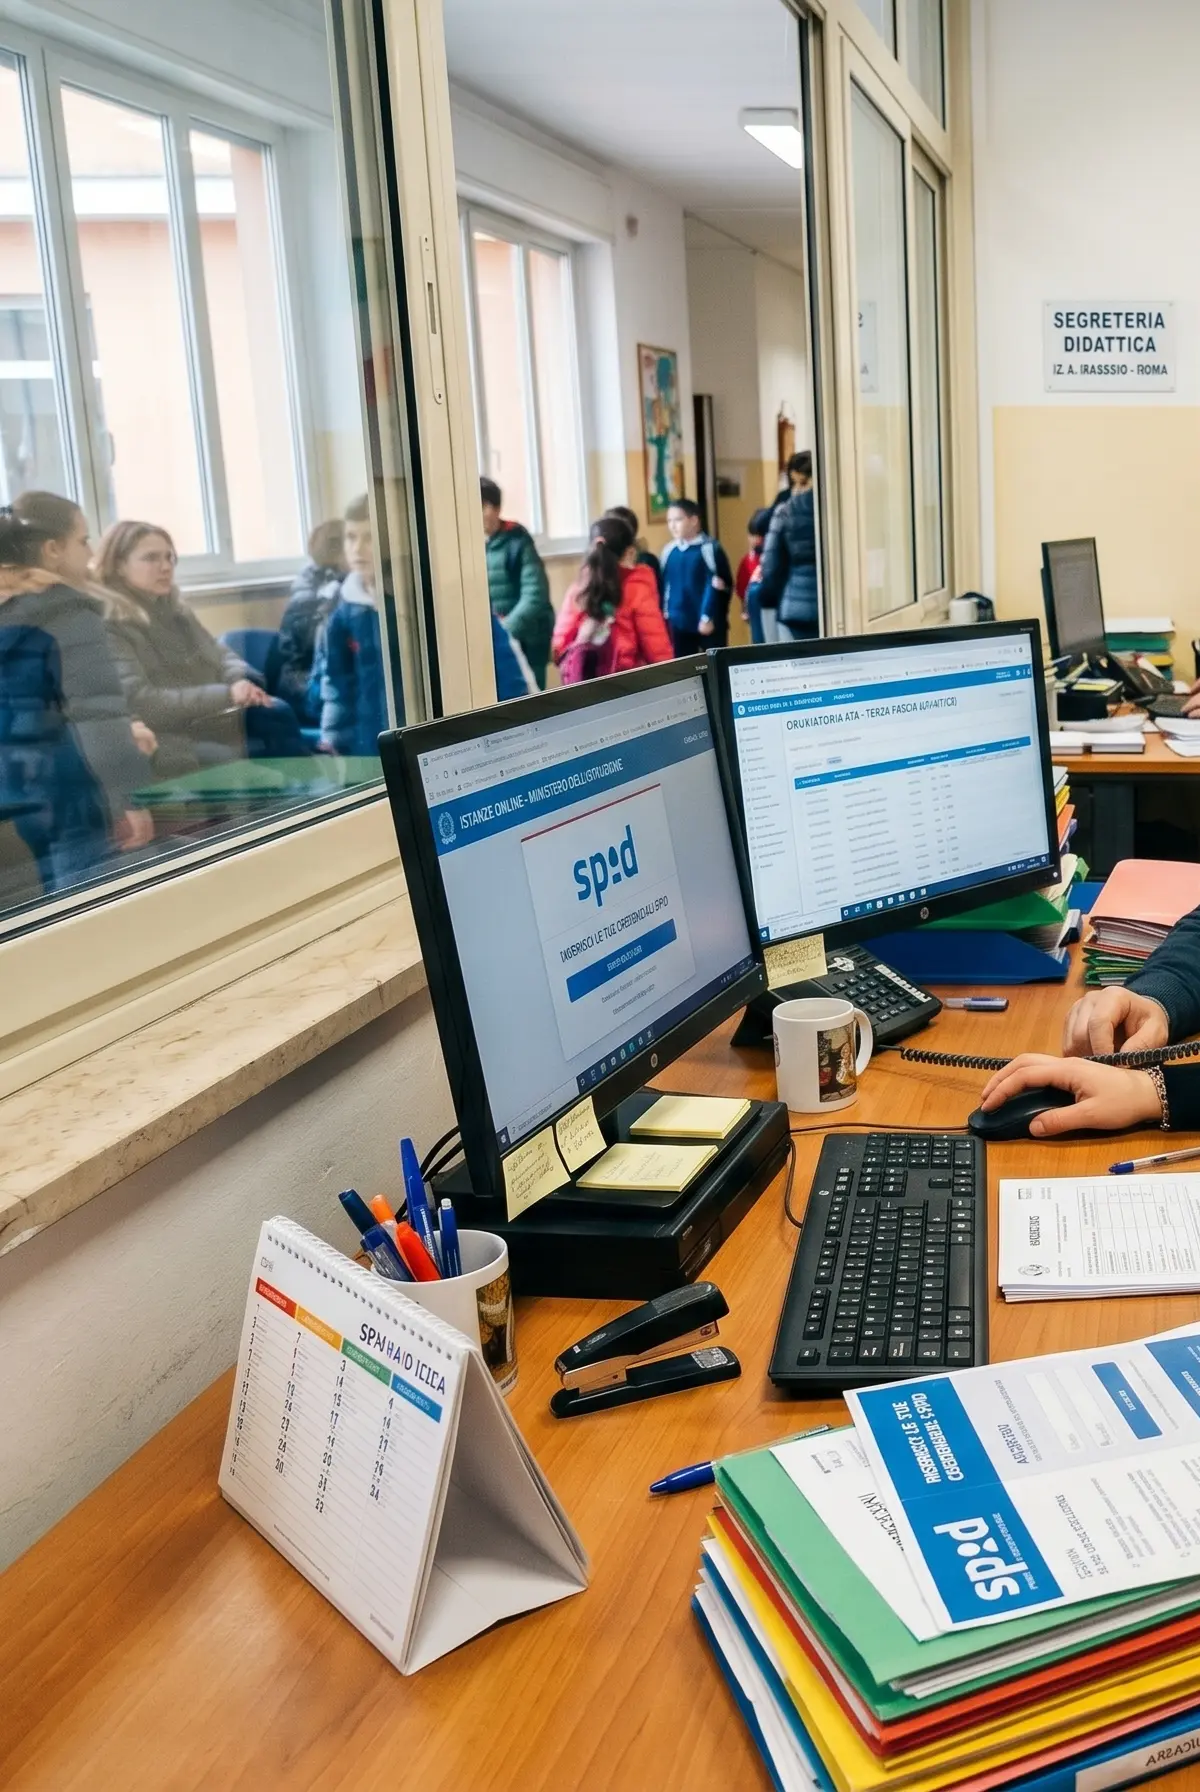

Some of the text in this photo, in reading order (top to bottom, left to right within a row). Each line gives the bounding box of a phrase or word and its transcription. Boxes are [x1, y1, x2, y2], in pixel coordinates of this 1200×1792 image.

[1053, 312, 1165, 329] SEGRETERIA
[1064, 336, 1156, 352] DIDATTICA
[1137, 364, 1168, 375] ROMA
[844, 709, 860, 722] ATA
[865, 704, 890, 718] TERZA
[460, 808, 496, 829] ISTANZE
[495, 799, 524, 817] ONLINE
[573, 824, 639, 907] spid
[340, 1360, 346, 1372] 3
[933, 1517, 1029, 1601] spid
